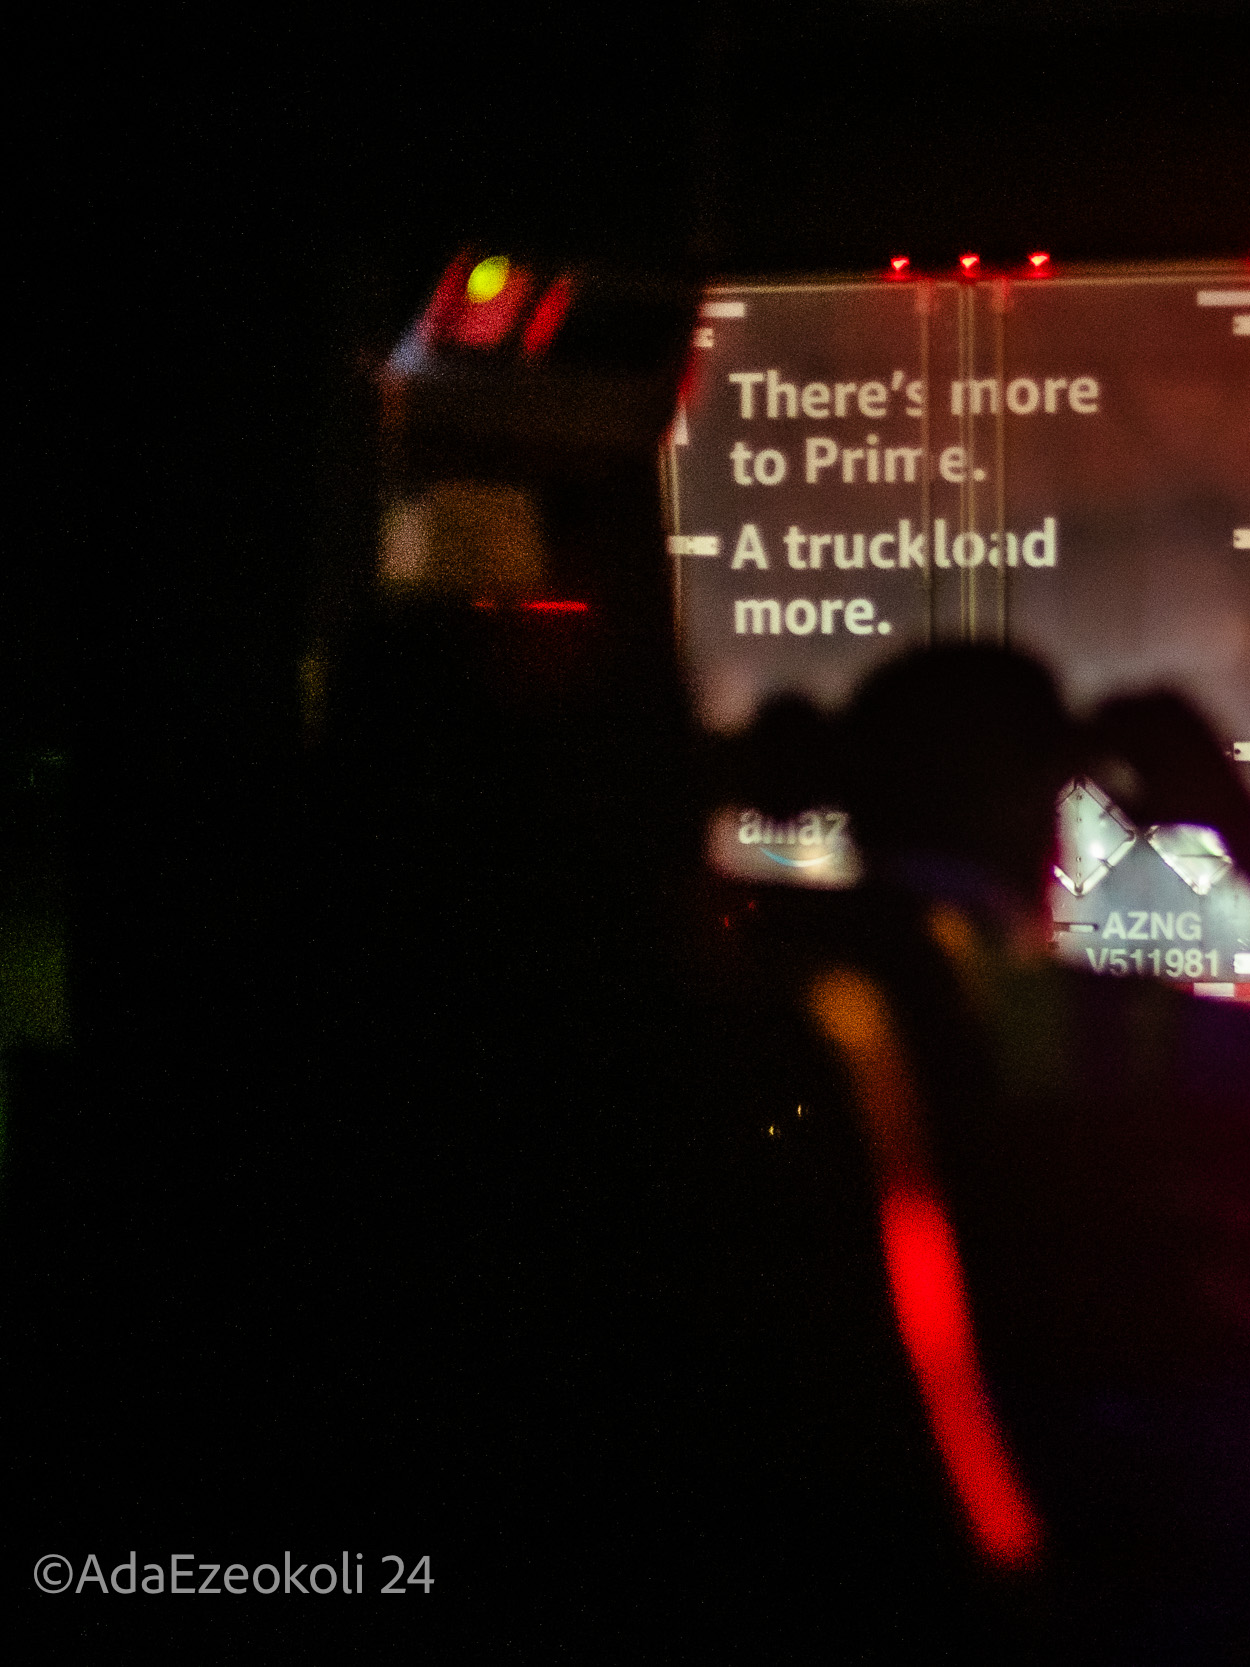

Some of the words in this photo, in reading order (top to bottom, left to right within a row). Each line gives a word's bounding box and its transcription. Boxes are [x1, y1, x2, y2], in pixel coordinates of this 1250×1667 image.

[728, 369, 925, 420] There's
[950, 375, 1100, 416] more
[729, 441, 787, 486] to
[805, 434, 987, 484] Prime.
[730, 524, 770, 570] A
[783, 517, 1058, 570] truckload
[734, 597, 893, 636] more.
[1102, 911, 1203, 941] AZNG
[1085, 947, 1219, 978] V511981
